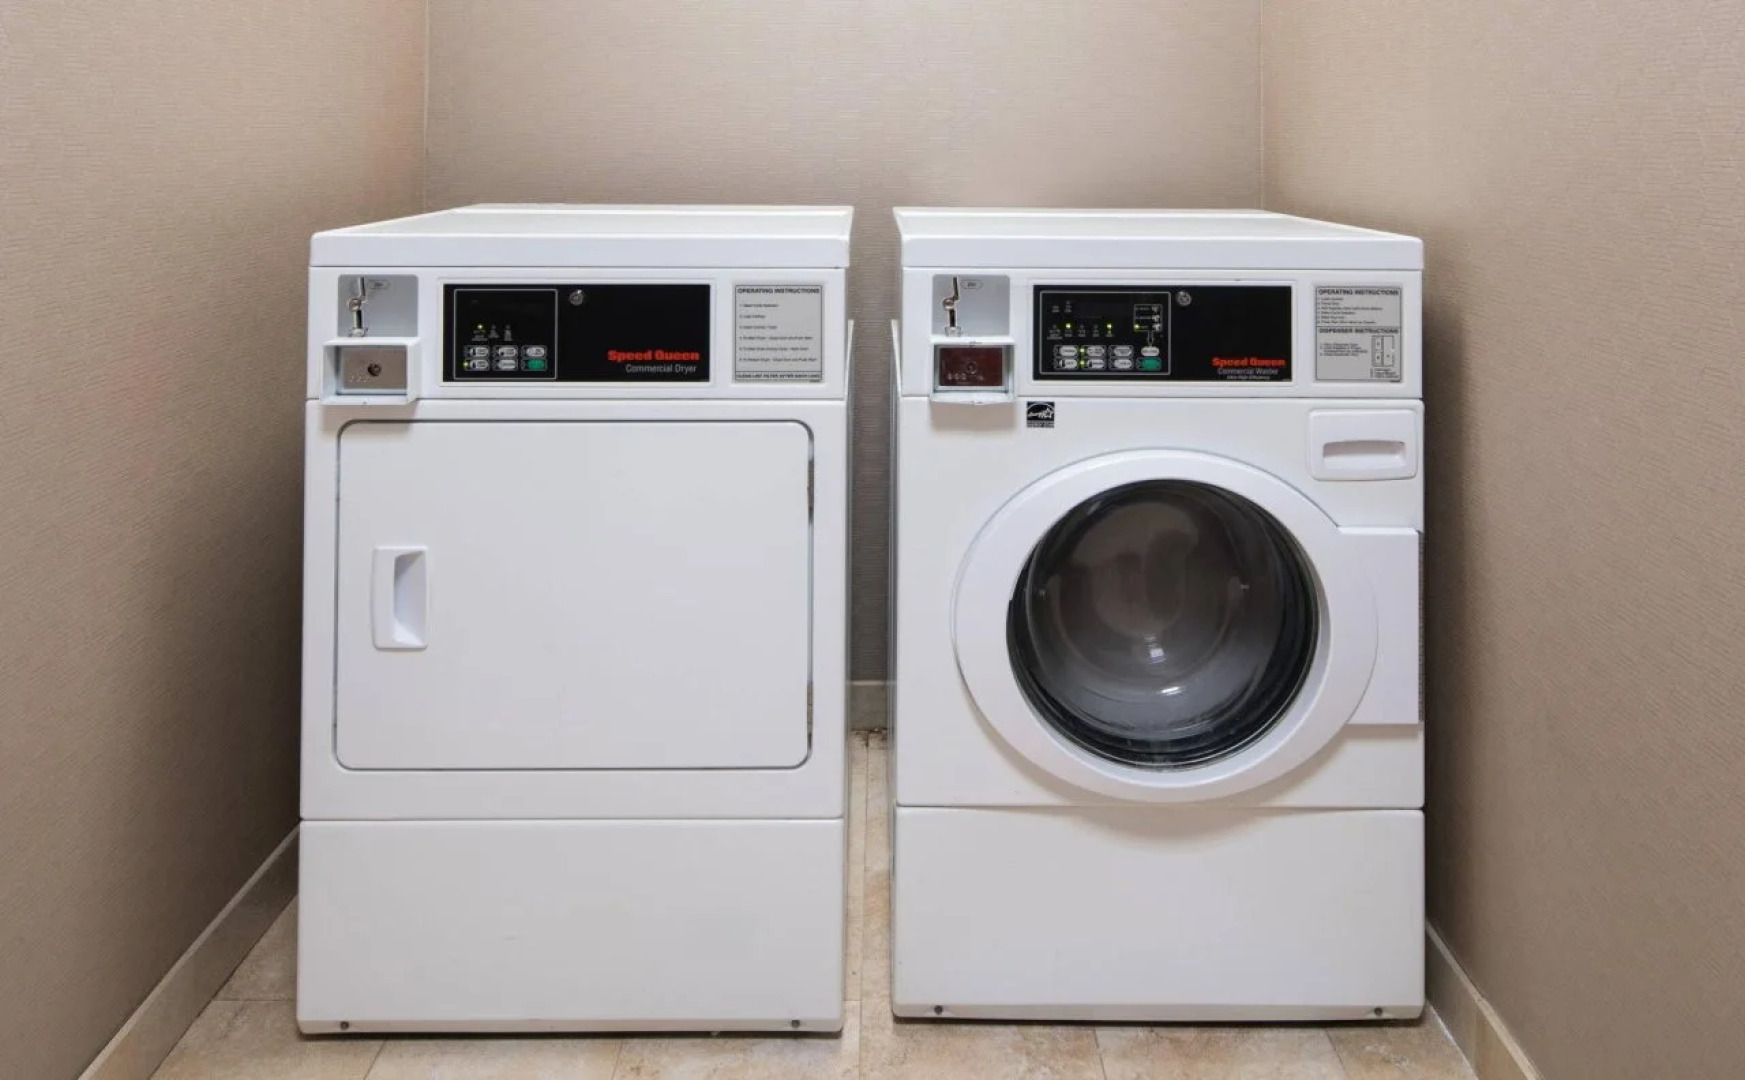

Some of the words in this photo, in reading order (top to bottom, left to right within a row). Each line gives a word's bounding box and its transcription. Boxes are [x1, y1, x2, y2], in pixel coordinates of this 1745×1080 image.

[608, 350, 652, 362] Speed
[655, 350, 699, 361] Queen
[1212, 358, 1248, 367] Speed
[1250, 358, 1285, 366] Queen
[625, 363, 672, 373] Commercial
[675, 363, 697, 374] Dryer
